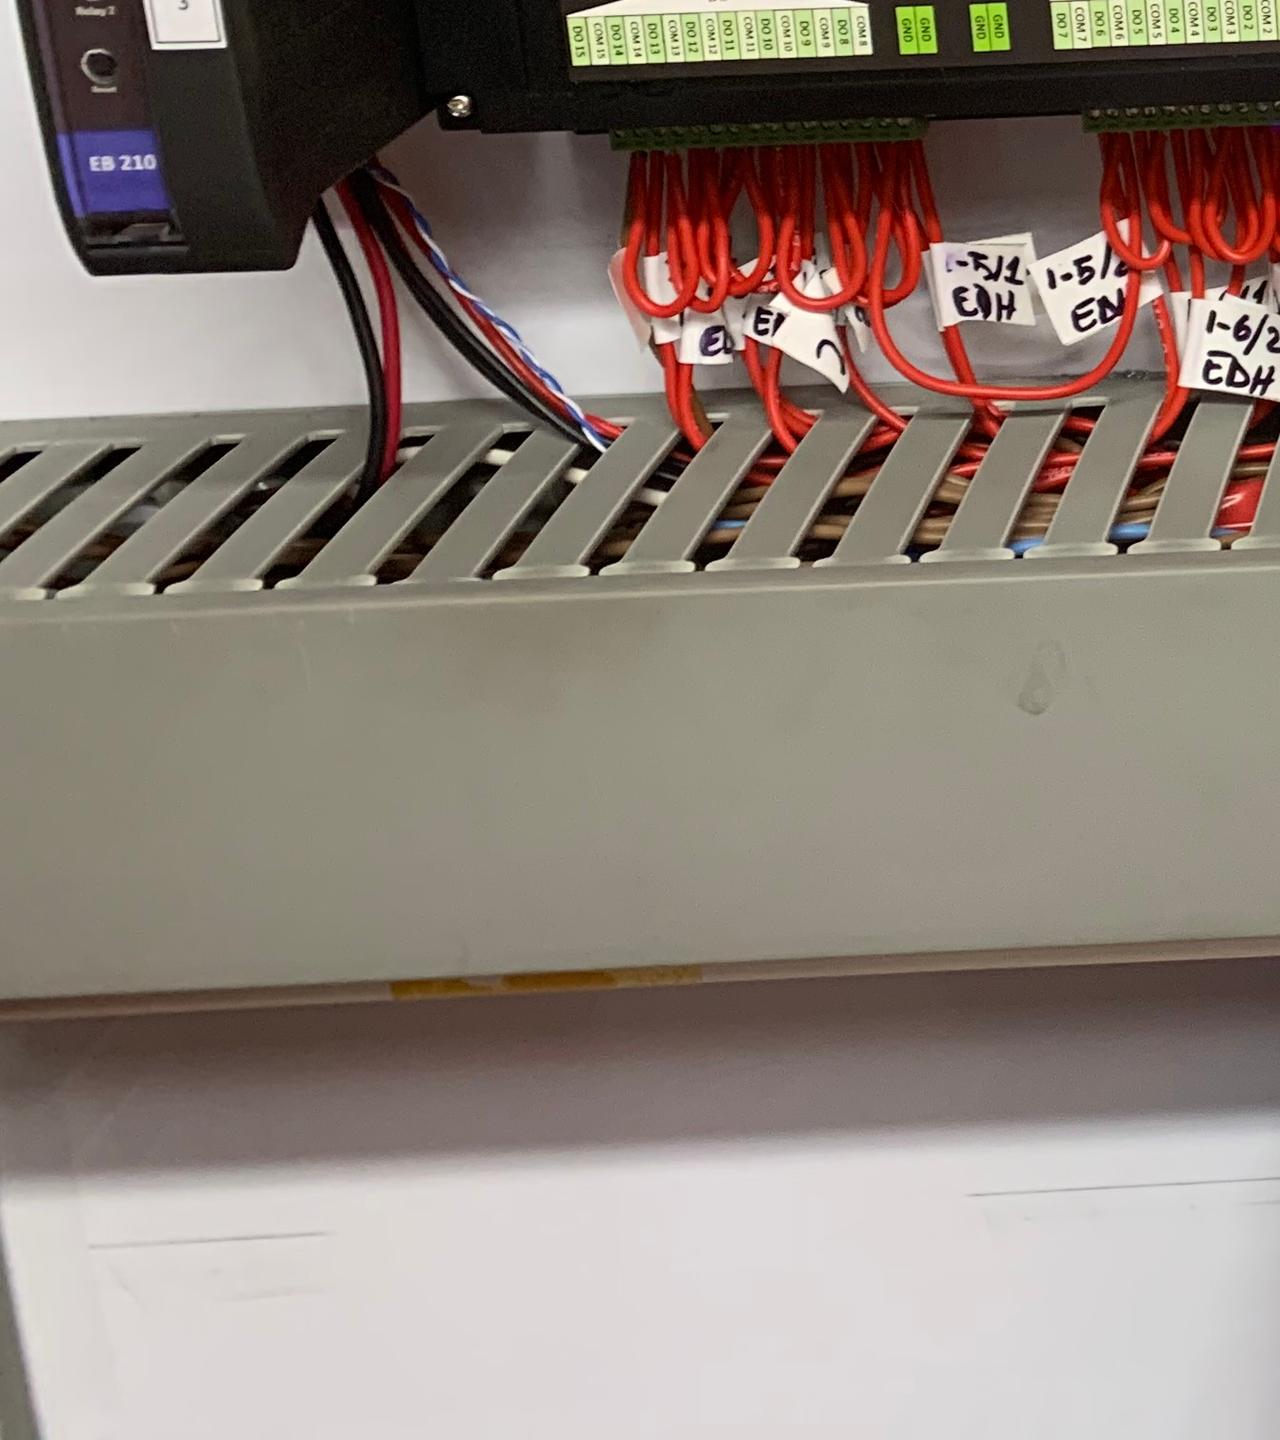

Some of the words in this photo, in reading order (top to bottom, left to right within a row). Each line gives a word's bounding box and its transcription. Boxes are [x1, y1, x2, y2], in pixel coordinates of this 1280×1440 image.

[90, 156, 115, 171] EB
[119, 154, 156, 170] 210
[1201, 350, 1276, 396] EDH
